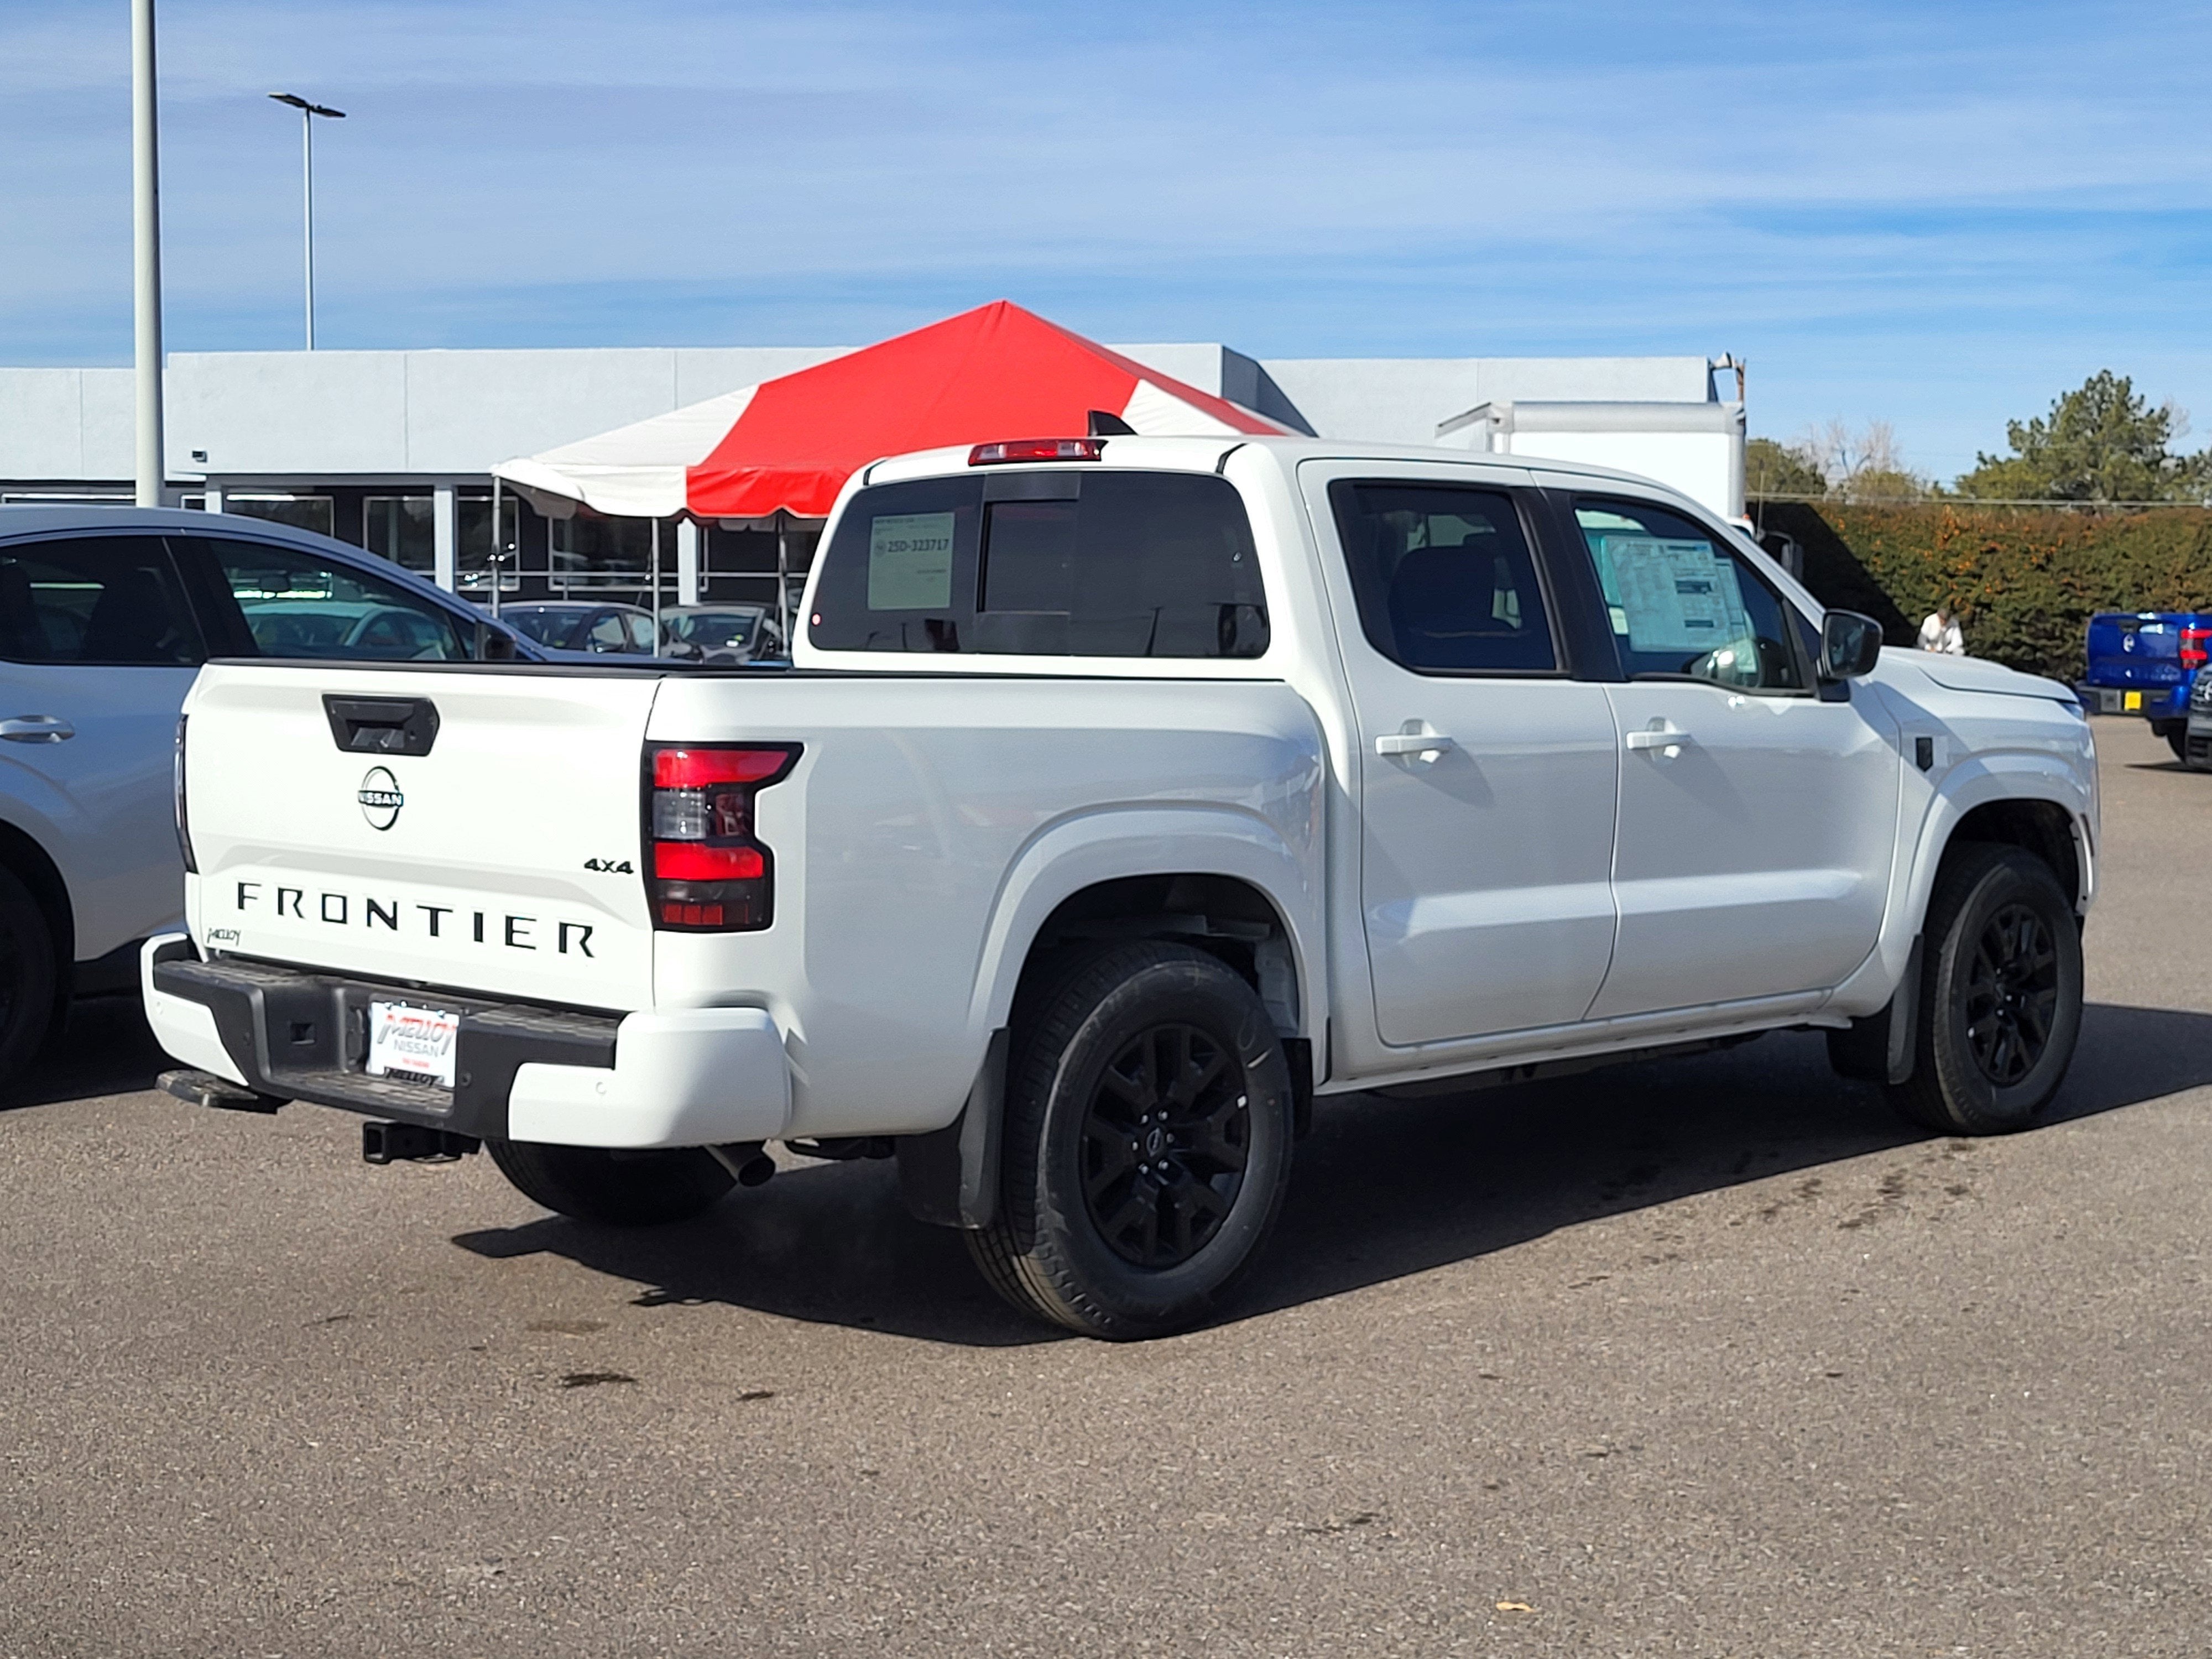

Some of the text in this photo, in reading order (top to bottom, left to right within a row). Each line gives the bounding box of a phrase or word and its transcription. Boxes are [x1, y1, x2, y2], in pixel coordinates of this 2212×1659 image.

[359, 792, 403, 806] SSAN
[237, 882, 596, 958] FRONTIER
[393, 1040, 439, 1057] NISSAN
